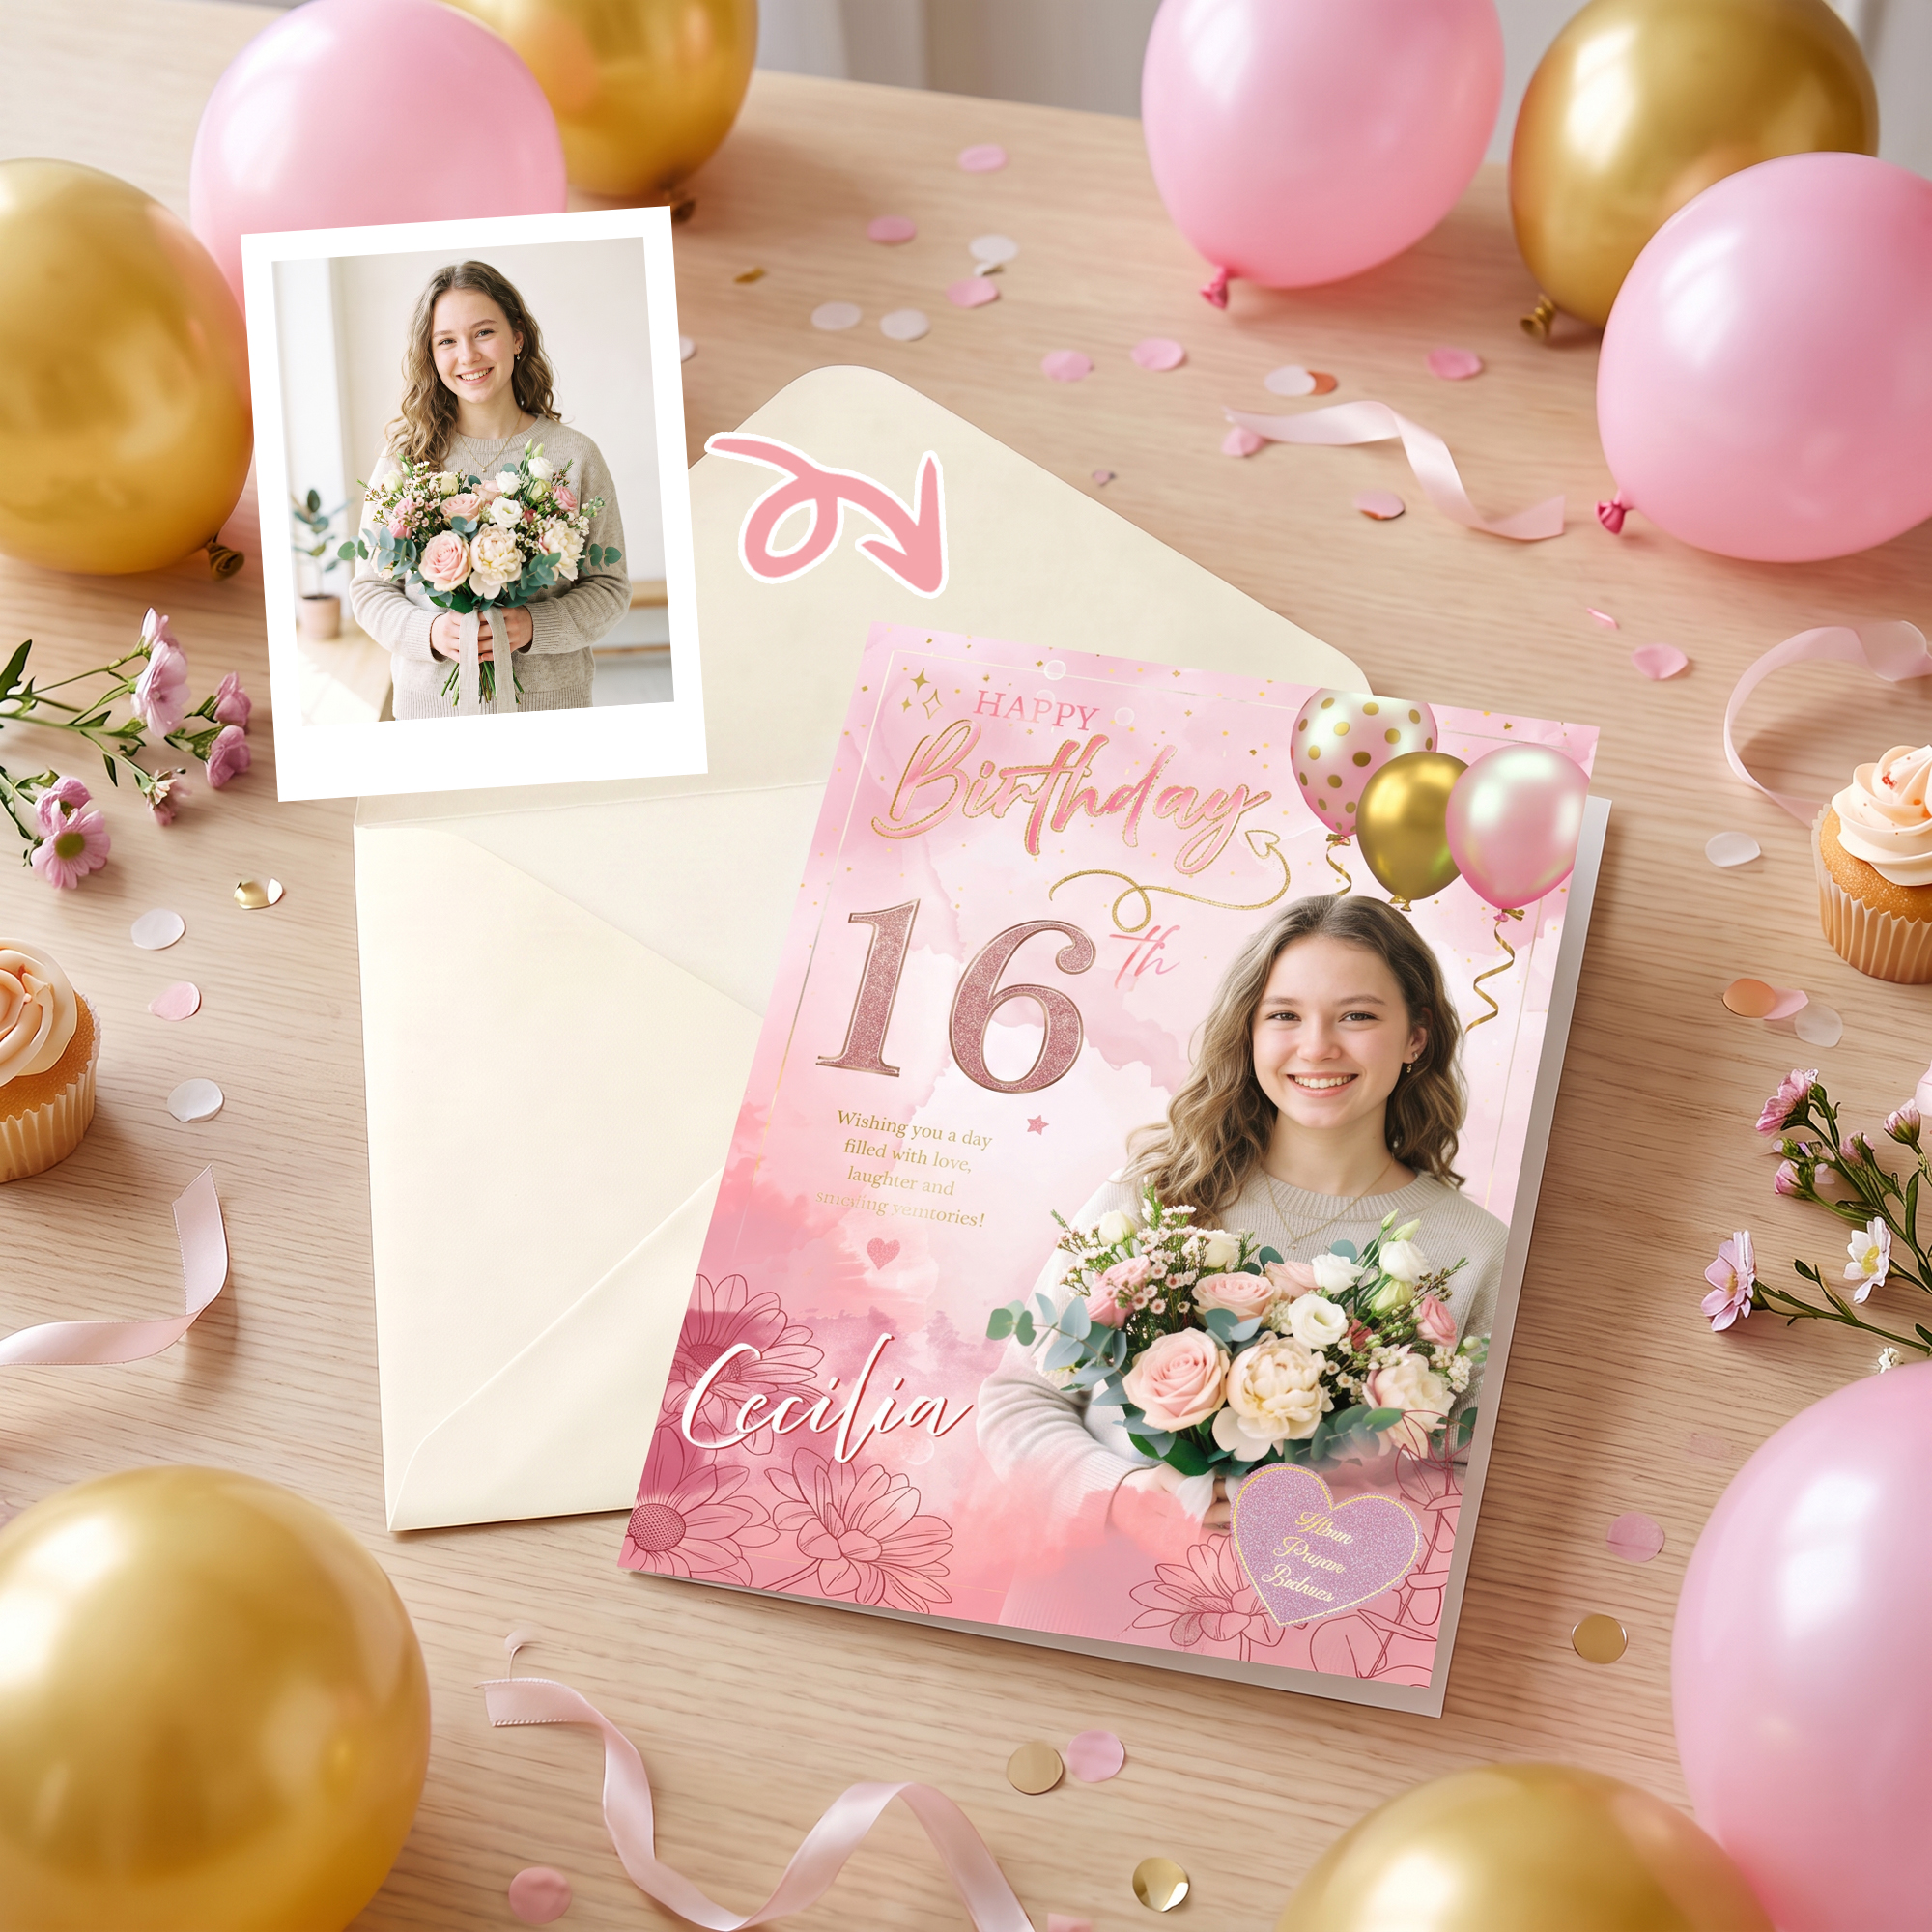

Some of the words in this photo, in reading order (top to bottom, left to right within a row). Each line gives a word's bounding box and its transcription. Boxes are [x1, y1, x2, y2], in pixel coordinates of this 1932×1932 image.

[974, 689, 1100, 730] HAPPY
[871, 719, 1272, 874] Birthday
[816, 898, 1095, 1094] 16
[838, 1109, 908, 1138] Wishing
[911, 1124, 943, 1141] you
[947, 1131, 957, 1143] a
[961, 1129, 993, 1151] day
[842, 1138, 887, 1158] filled
[891, 1148, 928, 1165] with
[931, 1151, 972, 1174] love,
[846, 1165, 918, 1189] laughter
[921, 1180, 955, 1196] and
[681, 1332, 974, 1464] Cecilia
